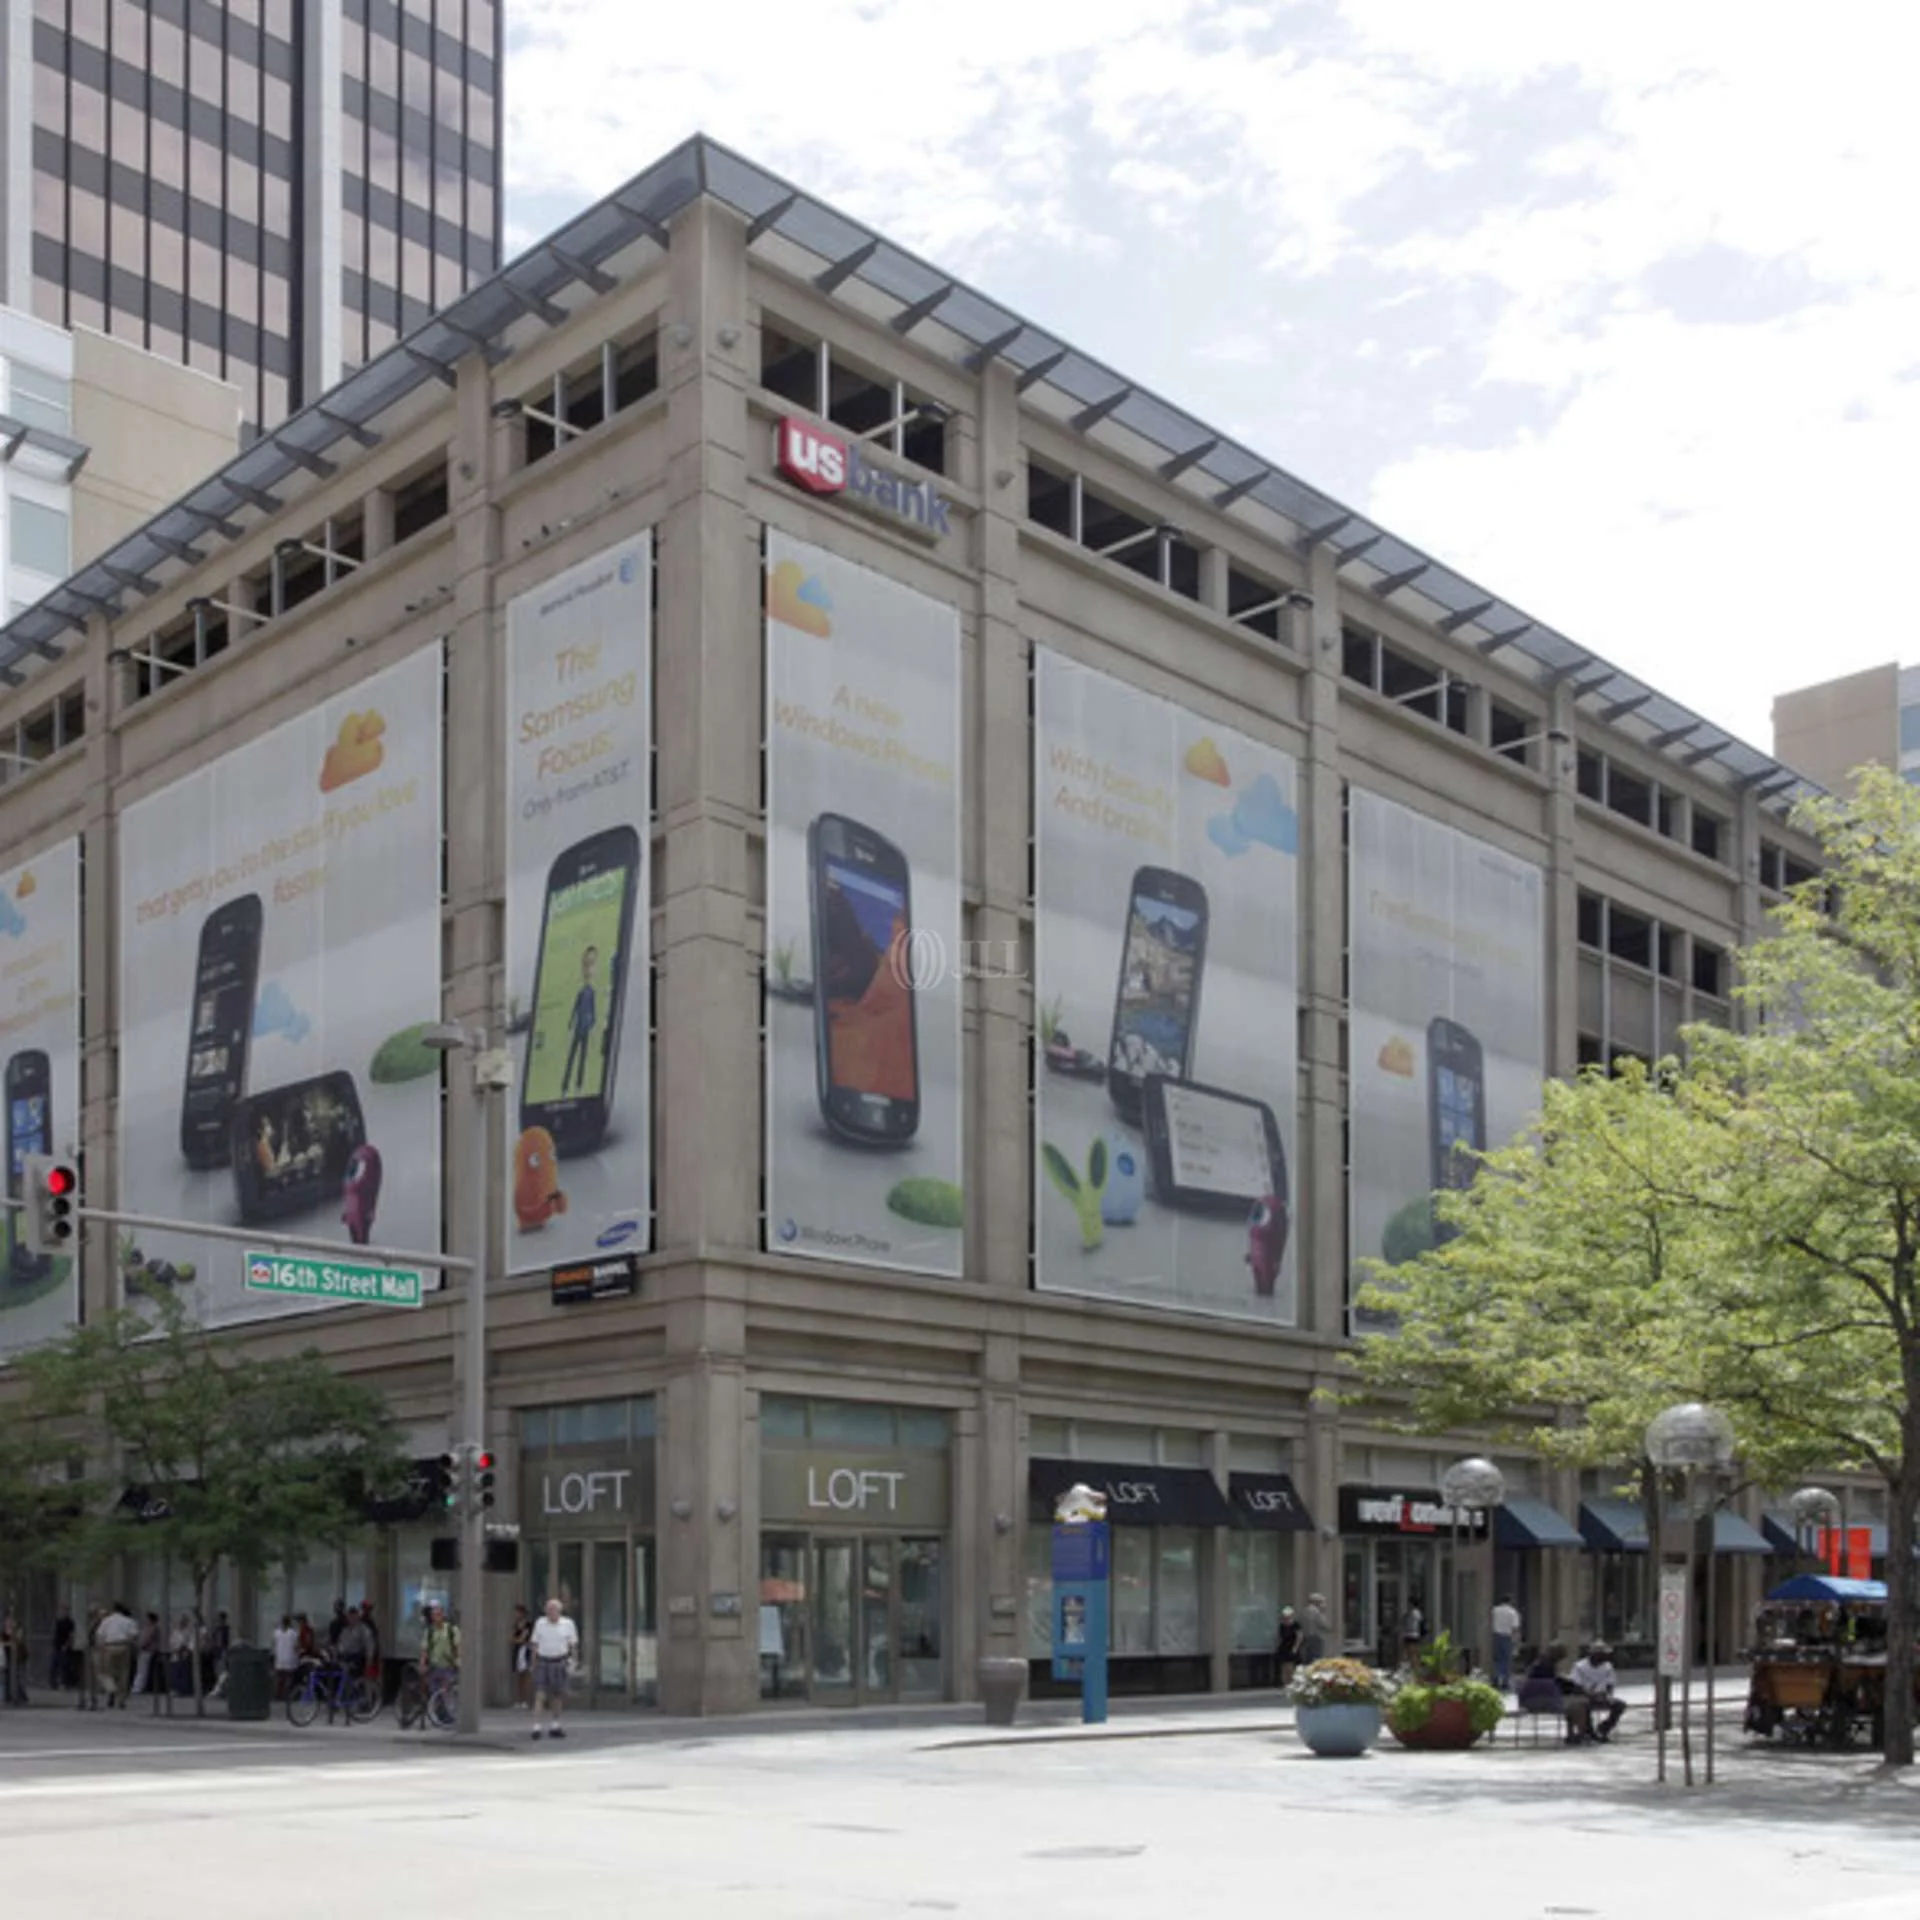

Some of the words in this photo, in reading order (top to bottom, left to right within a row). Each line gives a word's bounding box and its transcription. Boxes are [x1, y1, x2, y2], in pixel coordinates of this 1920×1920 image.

[788, 428, 845, 485] us
[849, 443, 950, 535] bank
[556, 644, 602, 684] The
[518, 669, 637, 744] Samsung
[774, 697, 880, 758] Windows
[271, 1261, 318, 1289] 16th
[321, 1266, 377, 1297] Street
[380, 1273, 415, 1299] Mall
[543, 1469, 631, 1514] LOFT
[808, 1467, 905, 1510] LOFT
[1106, 1481, 1160, 1505] LOFT
[1245, 1490, 1295, 1512] LOFT
